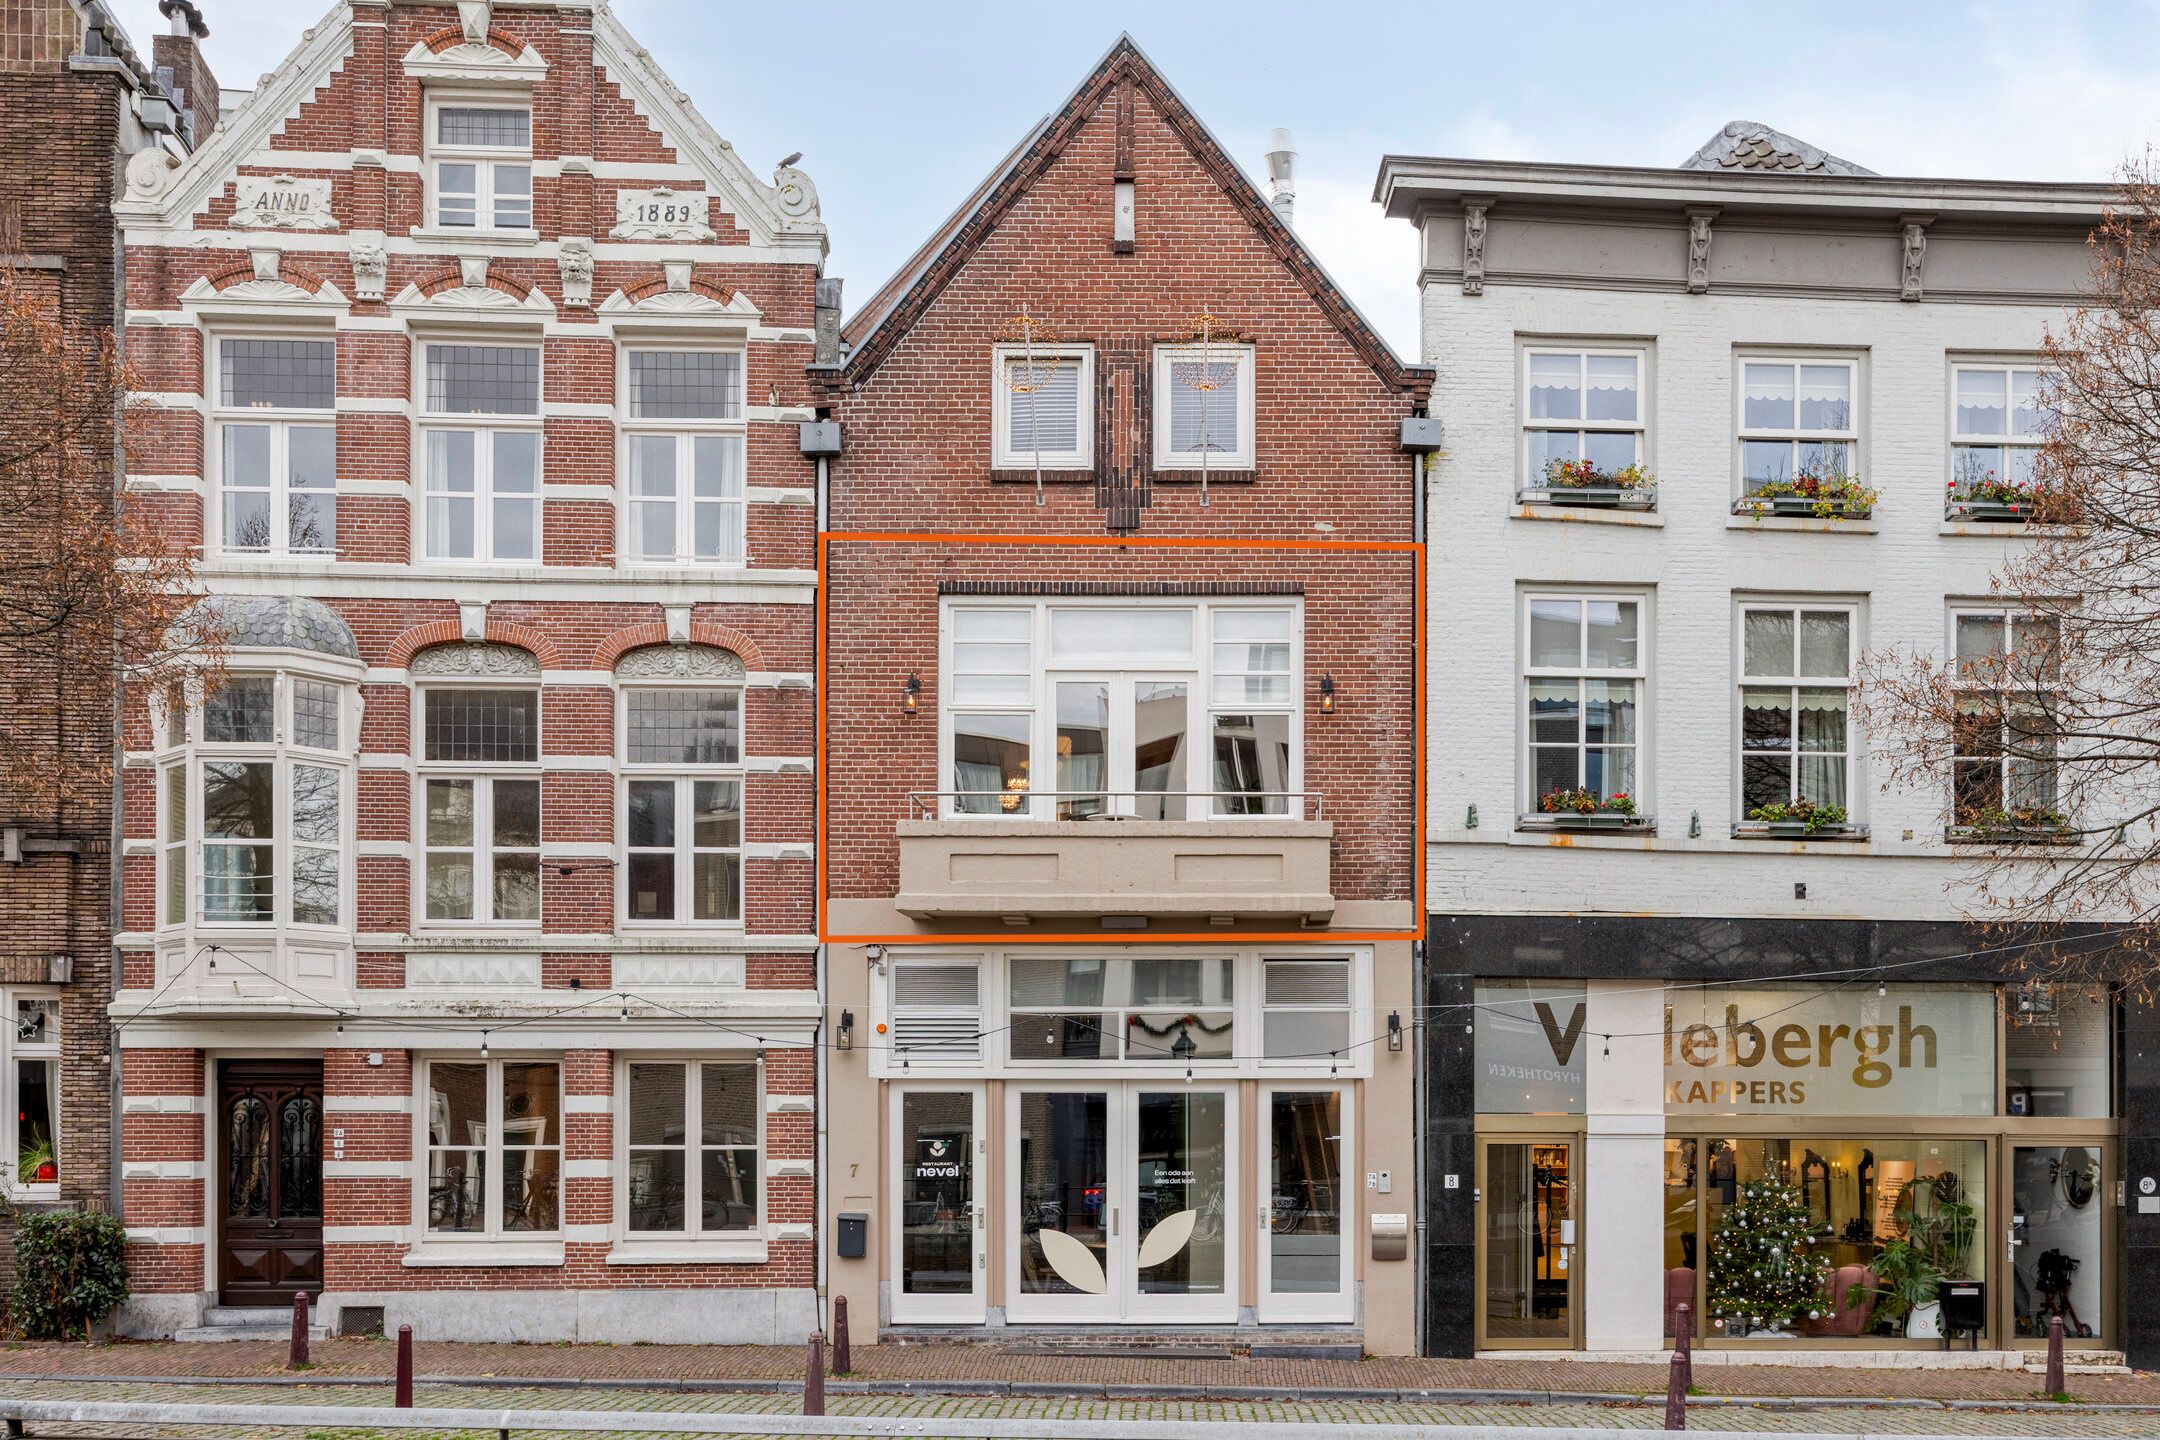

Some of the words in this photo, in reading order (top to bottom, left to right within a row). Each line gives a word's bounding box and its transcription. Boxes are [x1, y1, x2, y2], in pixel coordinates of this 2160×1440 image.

[254, 191, 310, 211] ANNO
[637, 204, 690, 222] 1889
[1664, 1080, 1806, 1105] KAPPERS
[850, 1163, 859, 1178] 7
[916, 1165, 959, 1177] nevel
[1449, 1176, 1454, 1187] 8
